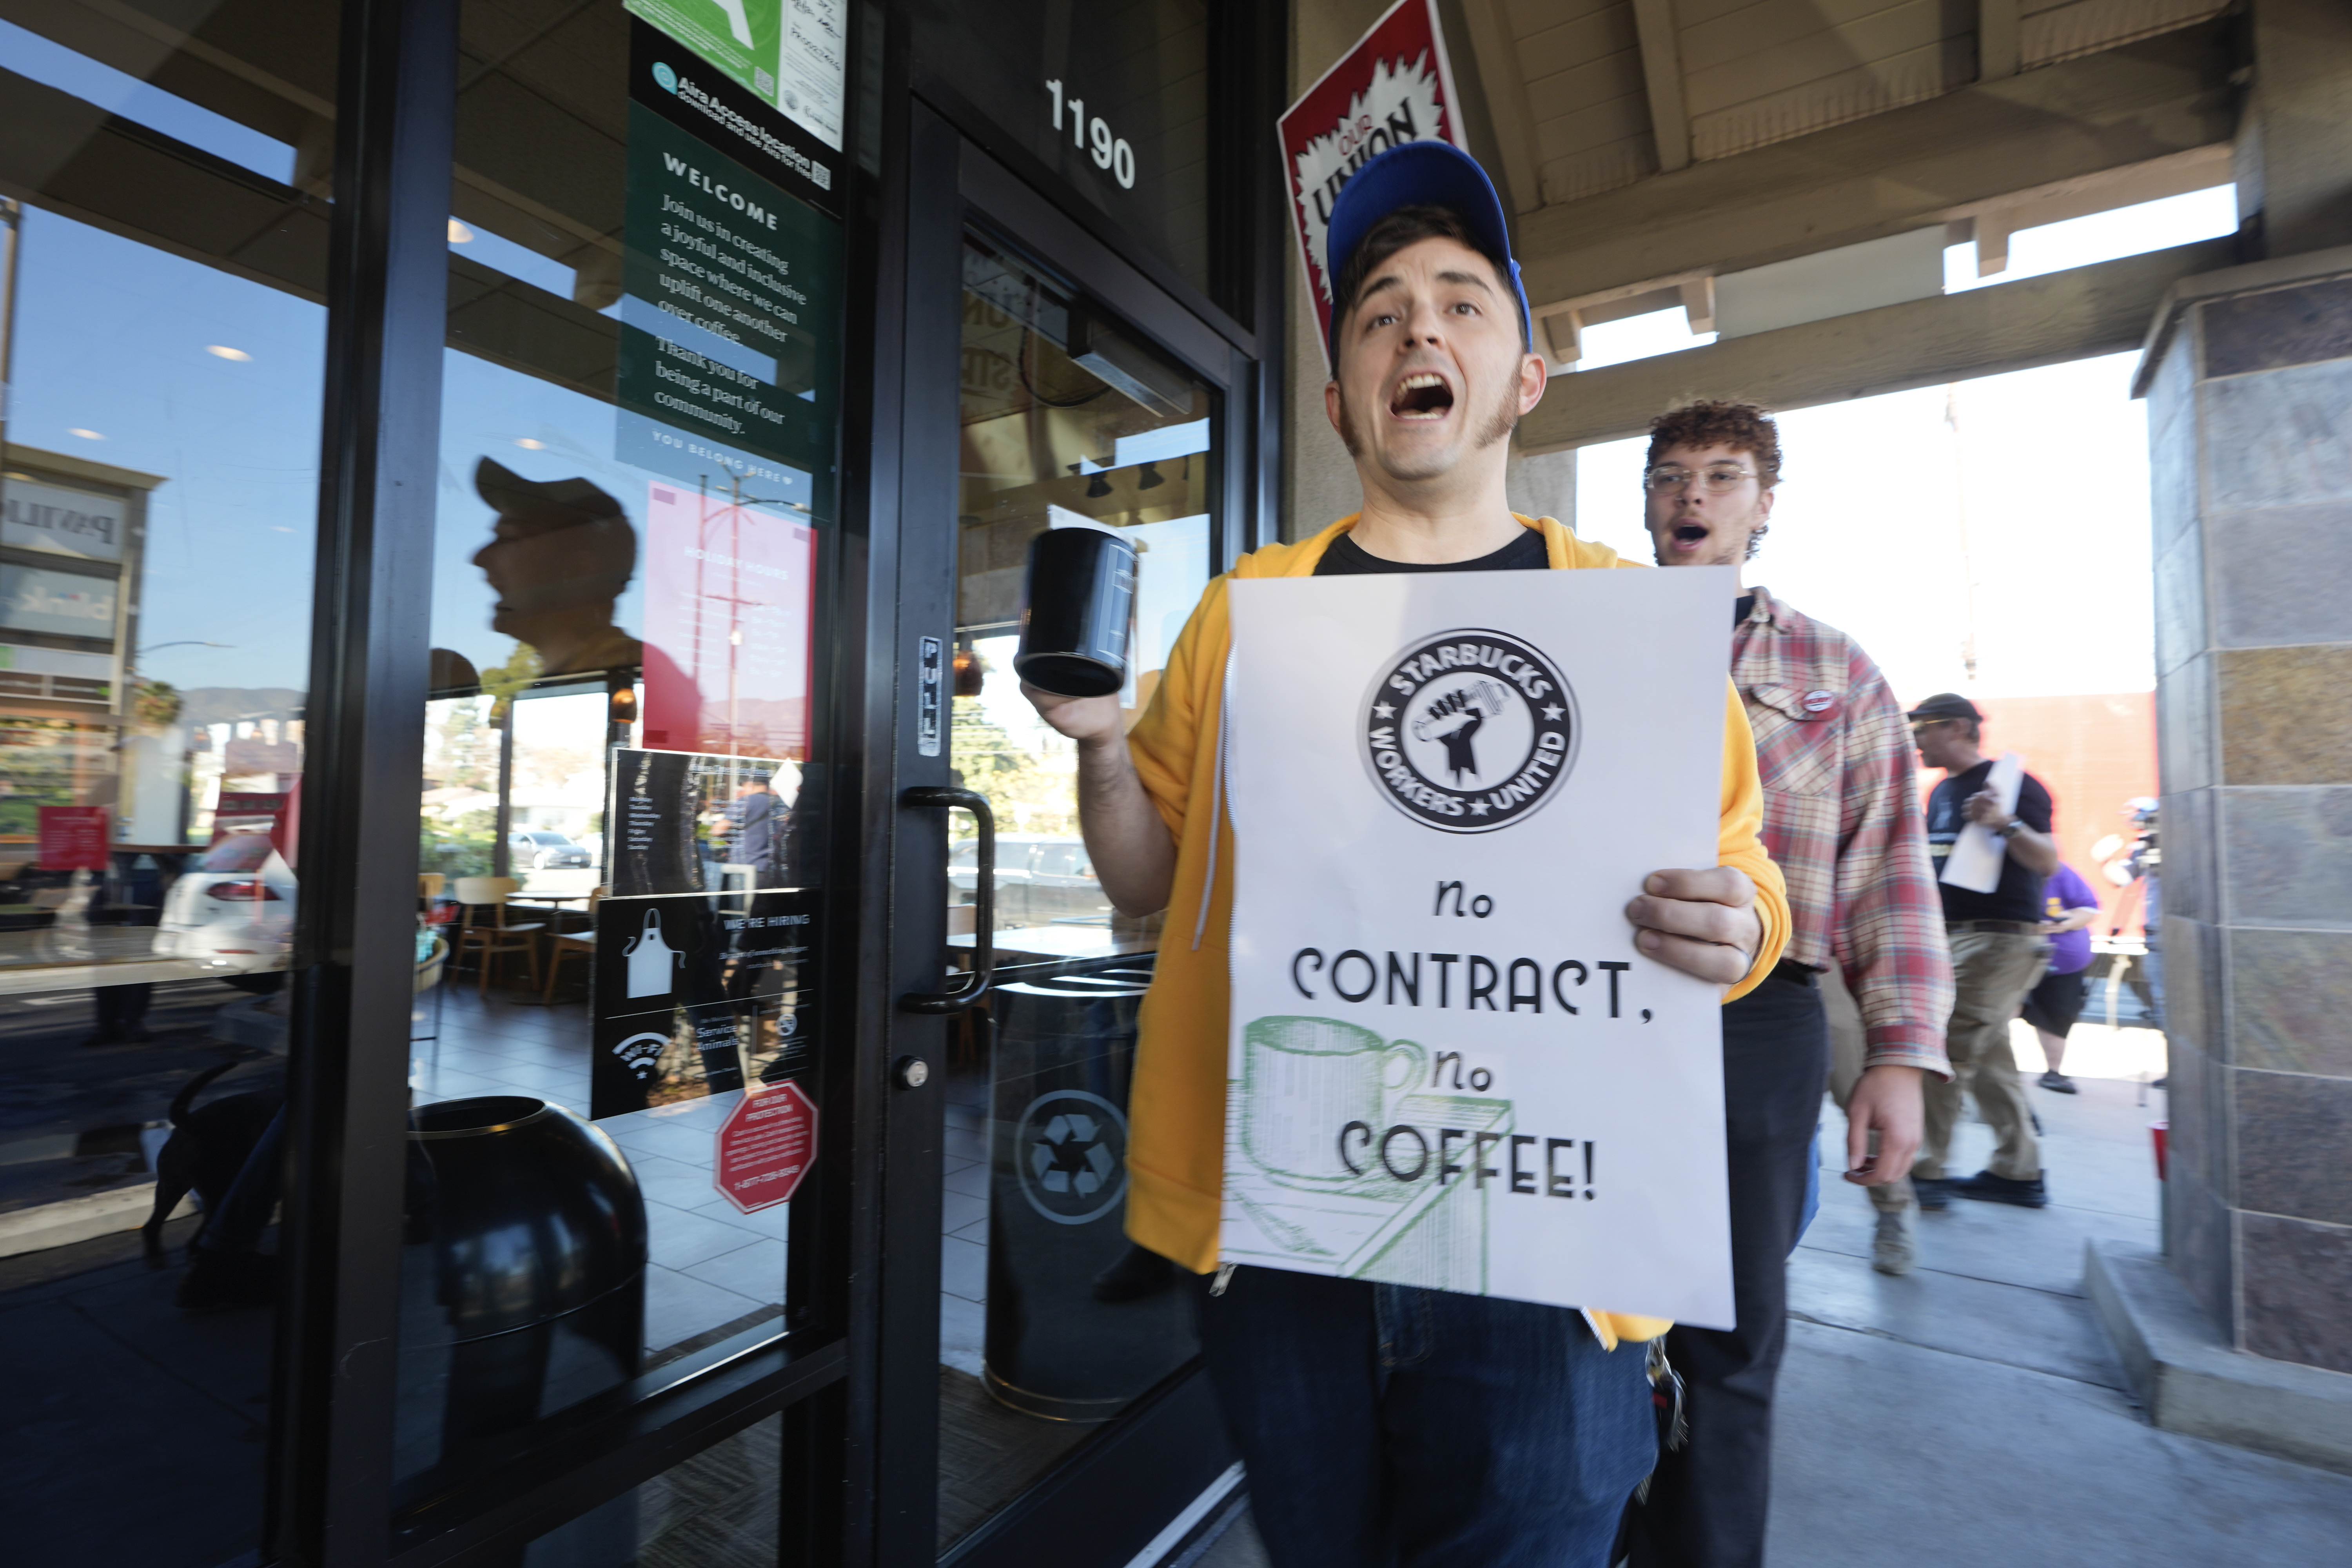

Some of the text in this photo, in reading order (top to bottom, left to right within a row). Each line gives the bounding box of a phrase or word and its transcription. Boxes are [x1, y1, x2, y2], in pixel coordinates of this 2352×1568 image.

[678, 78, 709, 105] Aira
[709, 98, 759, 136] Access
[678, 91, 812, 180] download and use Aira for free
[1045, 79, 1135, 189] 1190
[1338, 114, 1374, 156] OUR
[663, 152, 777, 230] WELCOME
[661, 194, 789, 275] Join us in creating
[660, 249, 797, 325] space where we can
[661, 223, 807, 305] a joyful and inclusive
[658, 301, 744, 347] over coffee.
[659, 274, 788, 342] uplift one another
[655, 336, 759, 390] Thank you for
[654, 392, 745, 434] community.
[655, 361, 785, 425] being a part of our
[652, 430, 780, 483] YOU BELONG HERE
[684, 545, 744, 570] HOLIDAY
[744, 563, 789, 581] HOURS
[924, 641, 938, 735] PULL
[1389, 643, 1553, 700] STARBUCKS
[1369, 726, 1566, 816] WORKERS UNITED
[724, 914, 810, 930] WE'RE HIRING
[1432, 880, 1496, 918] no
[1290, 947, 1654, 1024] CONTRACT,
[696, 1024, 739, 1038] Service
[696, 1036, 740, 1052] Animals
[1431, 1051, 1495, 1092] no
[1340, 1120, 1597, 1201] COFFEE!
